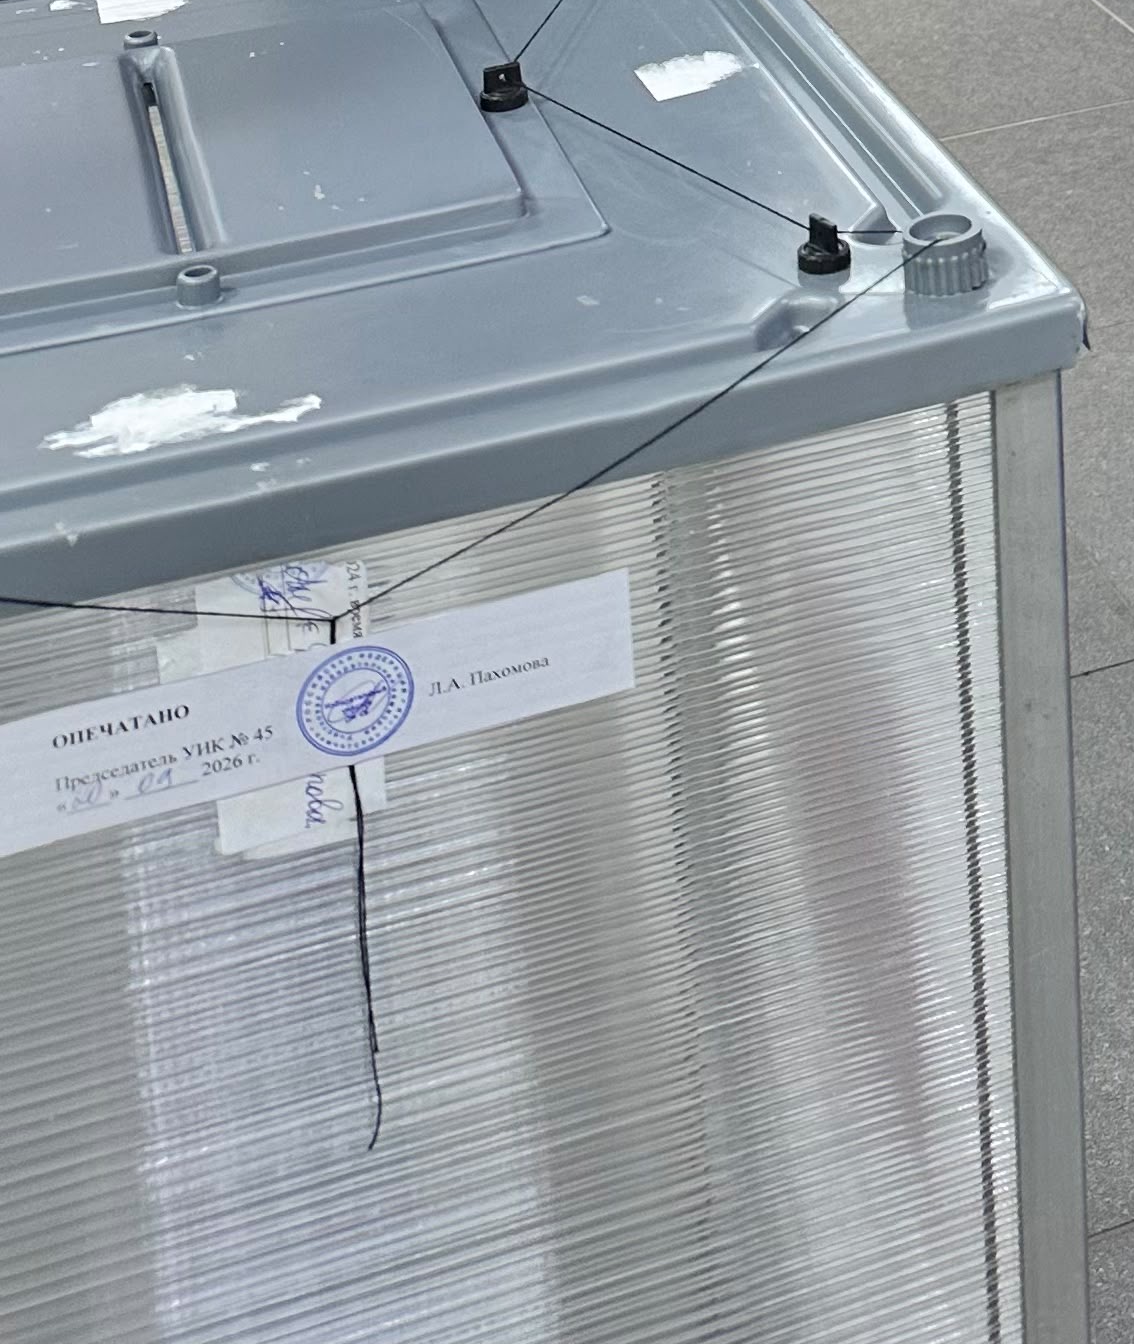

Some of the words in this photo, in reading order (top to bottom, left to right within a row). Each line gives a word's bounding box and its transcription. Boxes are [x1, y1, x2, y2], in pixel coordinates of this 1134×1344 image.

[429, 678, 465, 696] Л.А.
[470, 657, 549, 686] Пахомова
[52, 704, 190, 749] ОПЕЧАТАНО
[55, 754, 177, 793] Председатель
[182, 737, 226, 760] УИК
[228, 732, 250, 750] №
[253, 725, 274, 742] 45
[202, 753, 243, 777] 2026
[247, 752, 261, 765] г.
